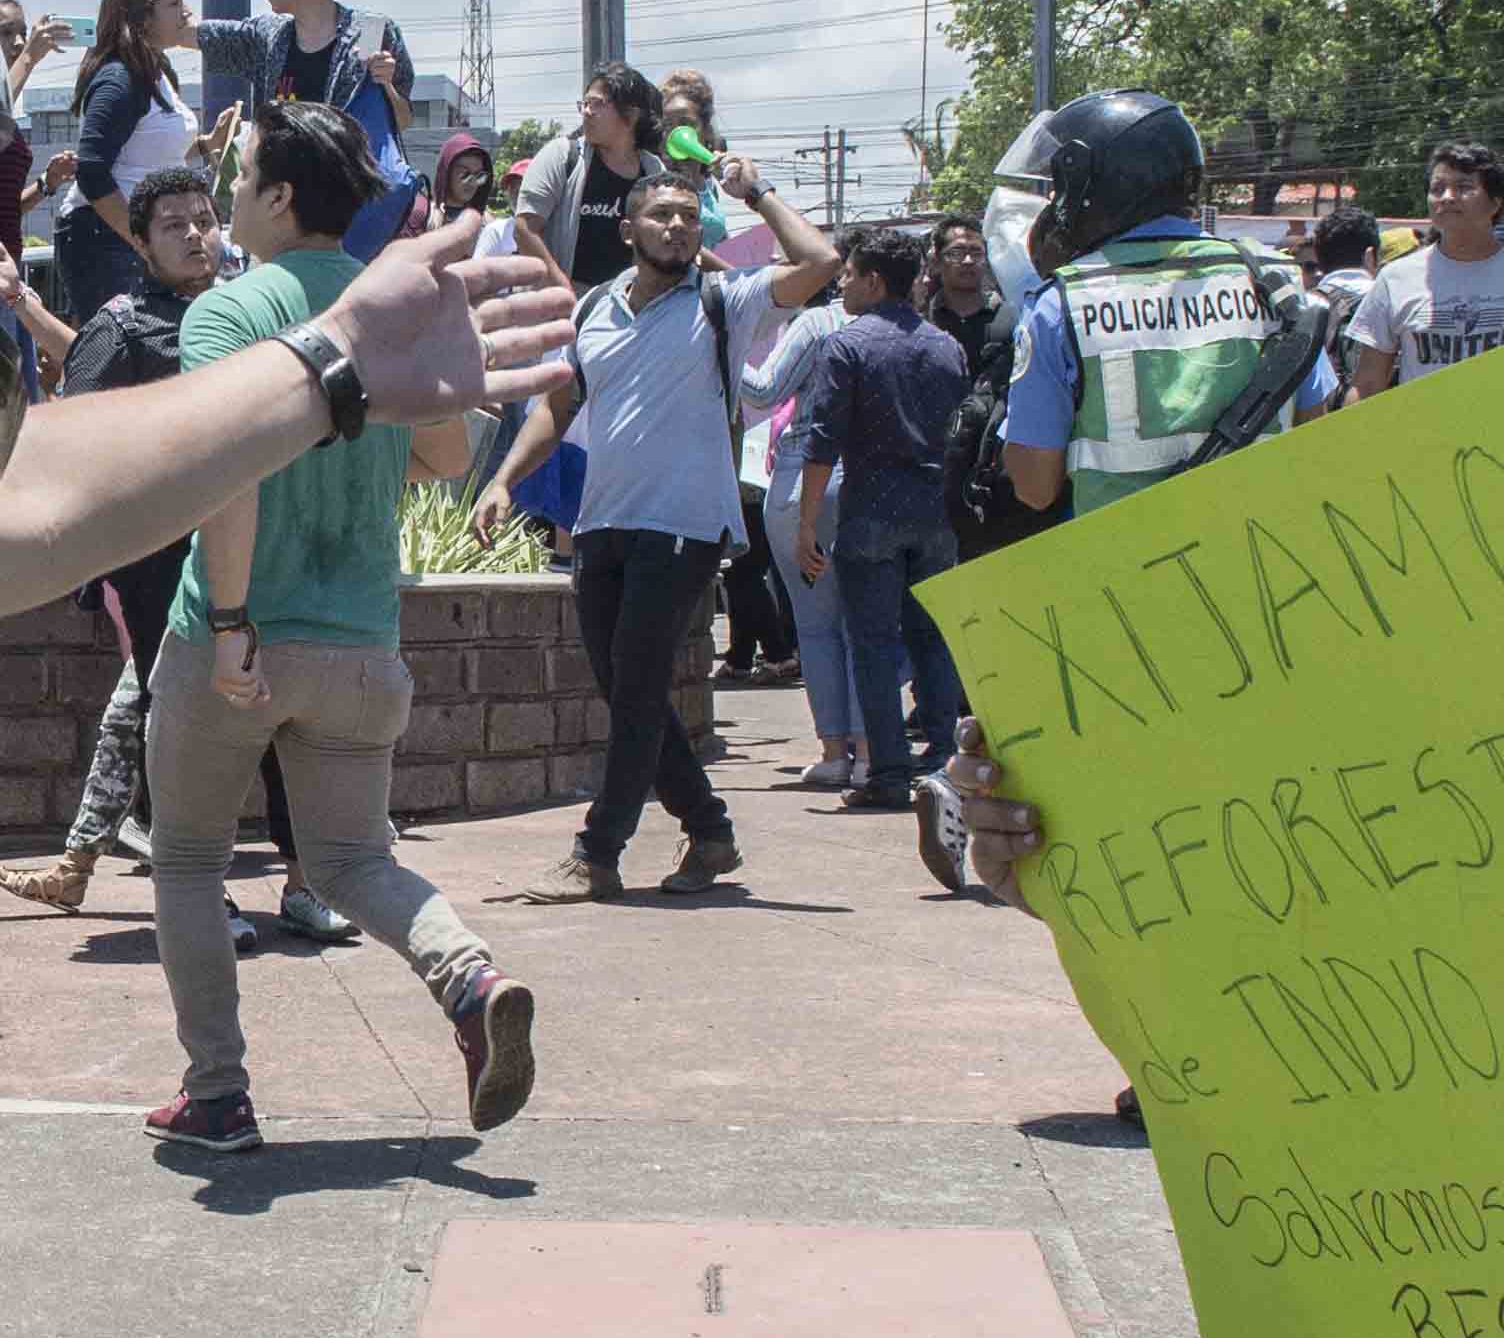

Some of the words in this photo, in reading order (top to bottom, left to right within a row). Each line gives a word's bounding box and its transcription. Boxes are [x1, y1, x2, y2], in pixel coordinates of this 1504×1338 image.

[1082, 297, 1178, 337] POLICIA
[1127, 998, 1219, 1104] de
[1221, 947, 1500, 1104] INDIO
